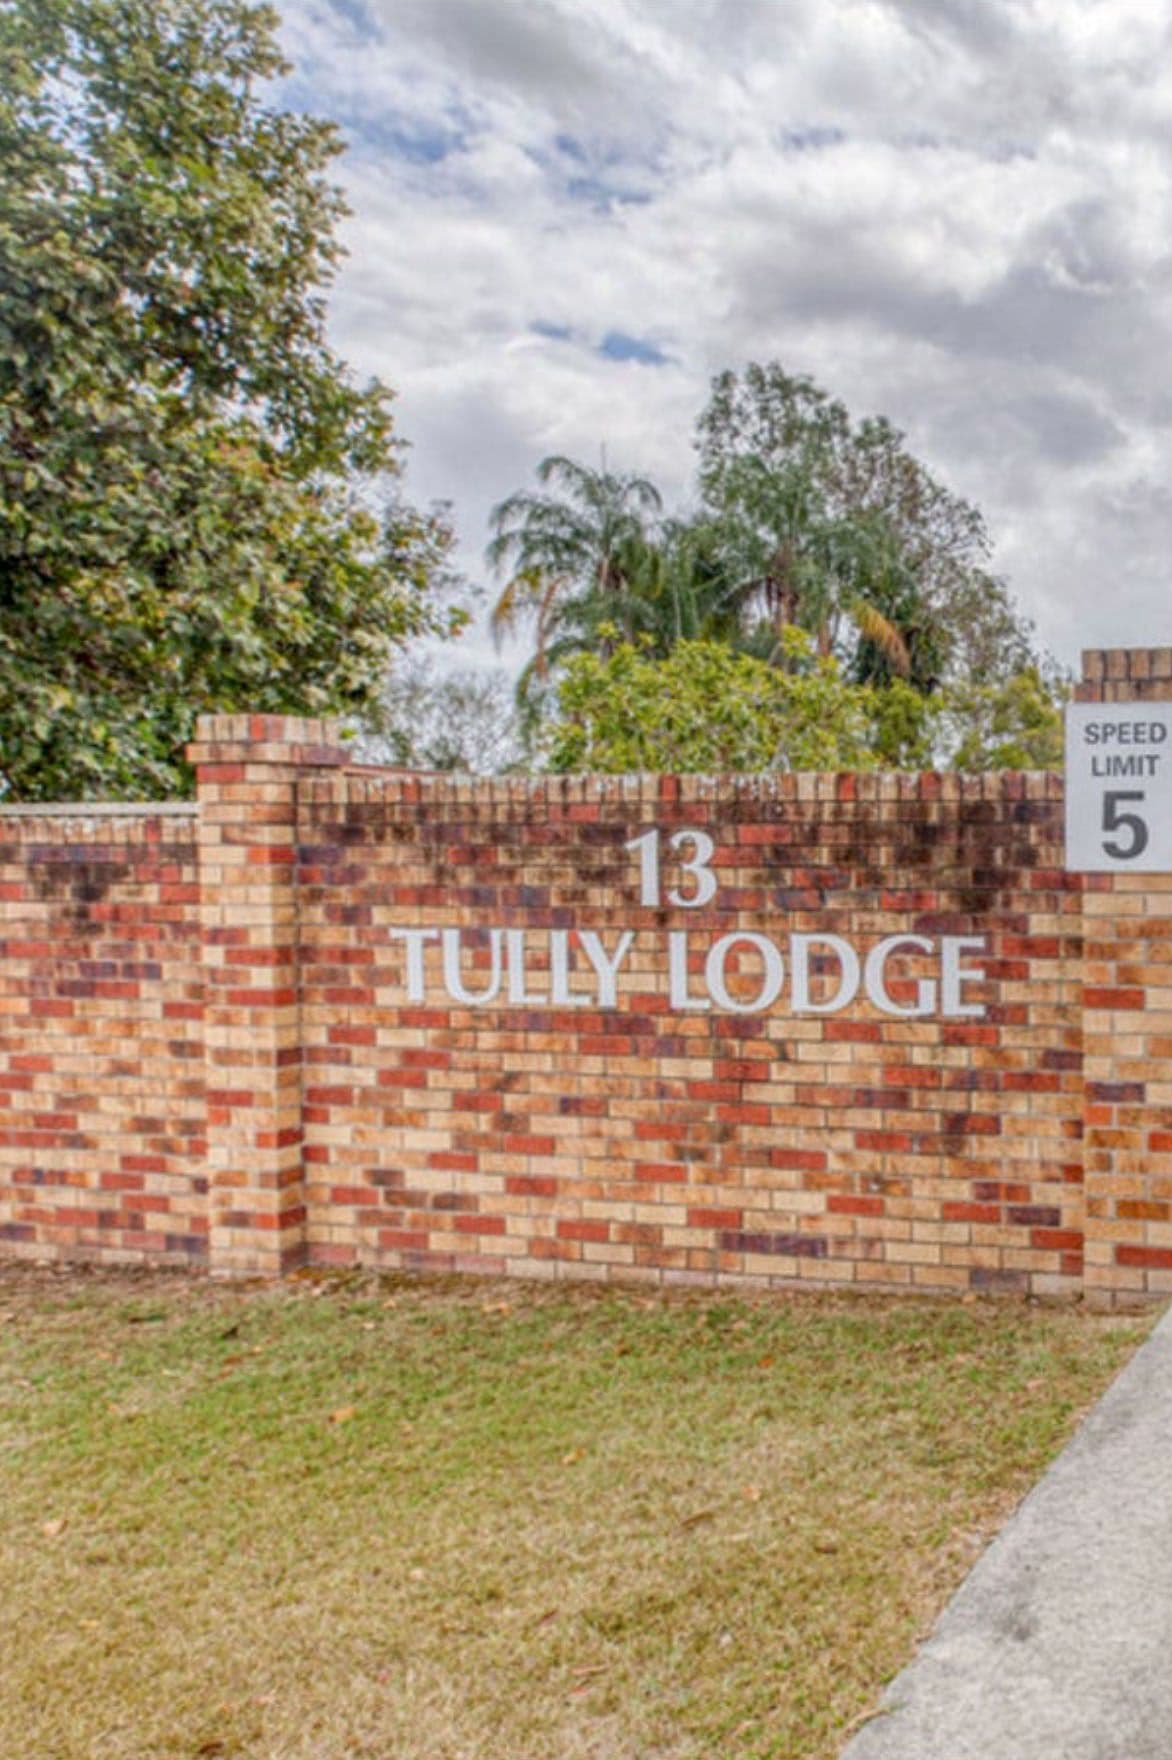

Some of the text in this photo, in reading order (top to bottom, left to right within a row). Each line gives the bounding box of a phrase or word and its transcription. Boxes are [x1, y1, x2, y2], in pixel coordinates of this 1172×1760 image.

[1084, 722, 1167, 744] SPEED
[1091, 755, 1160, 776] LIMIT
[1101, 791, 1148, 859] 5
[624, 828, 718, 907] 13
[389, 927, 988, 1018] TULLY LODGE
